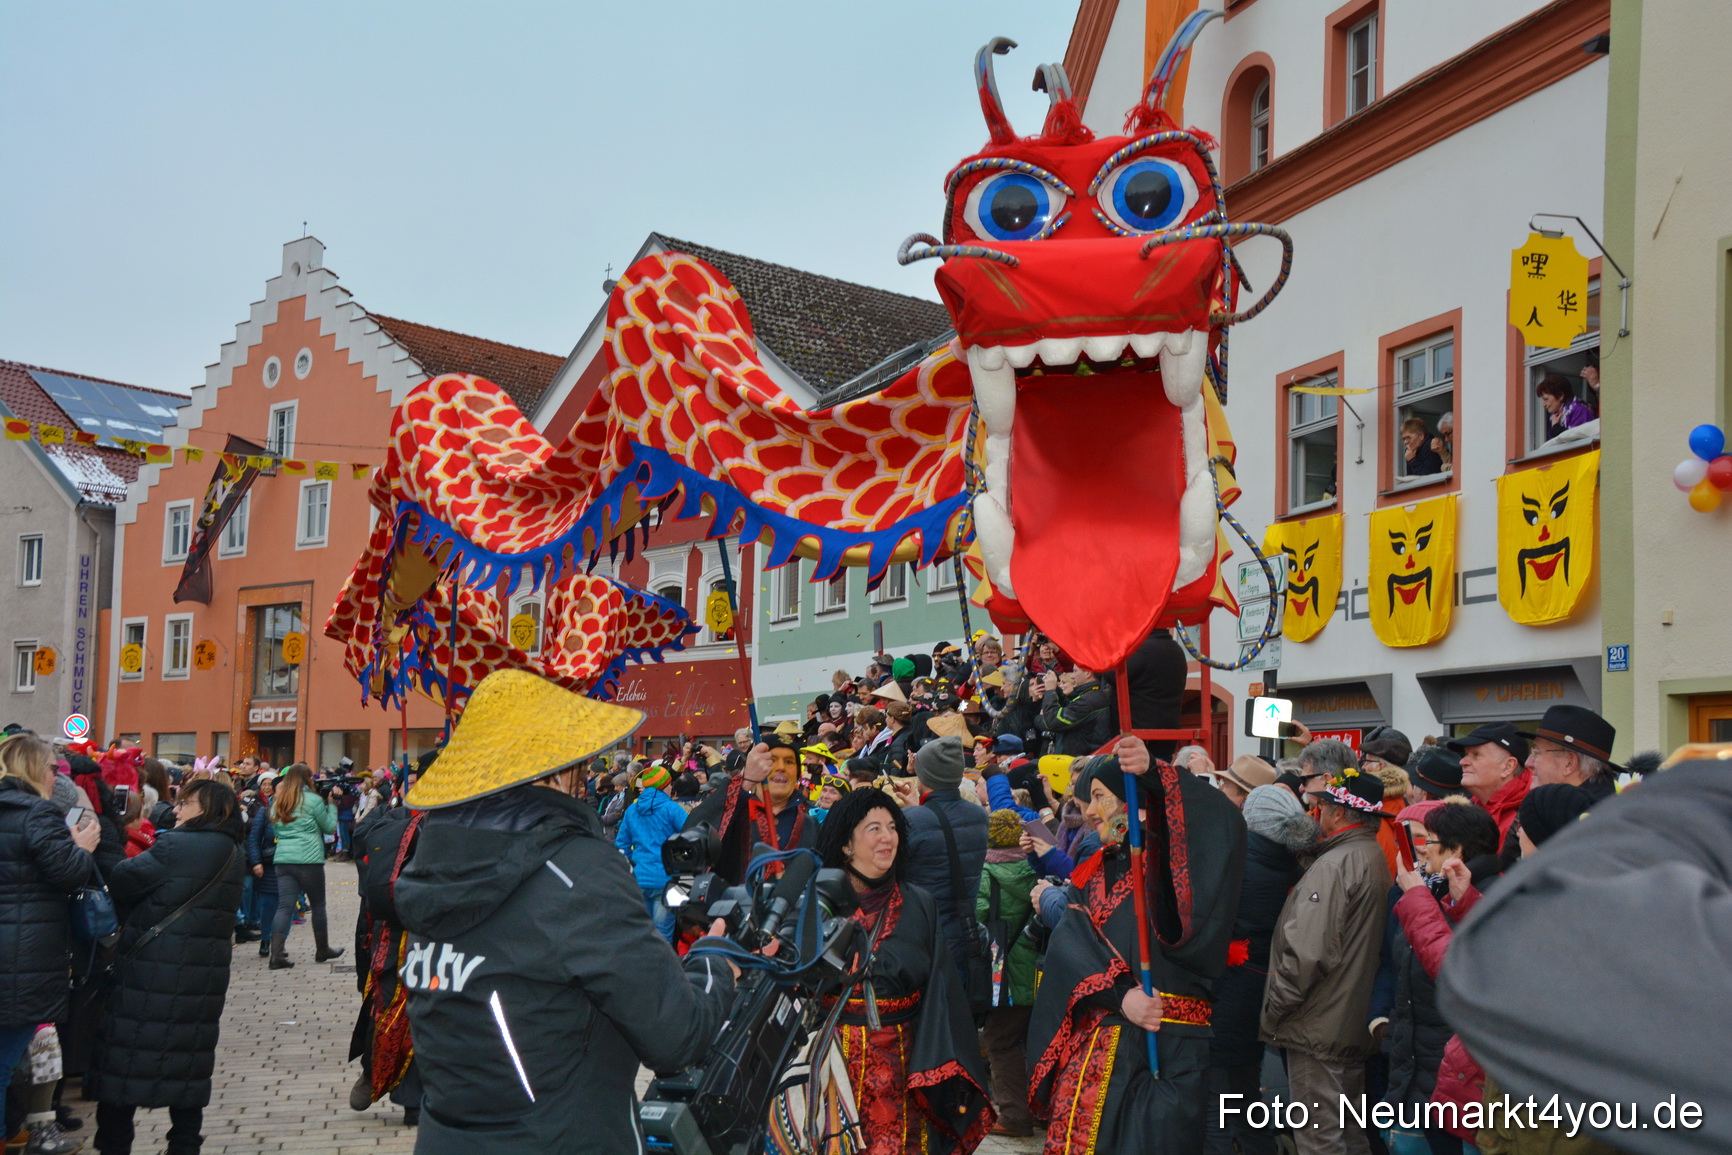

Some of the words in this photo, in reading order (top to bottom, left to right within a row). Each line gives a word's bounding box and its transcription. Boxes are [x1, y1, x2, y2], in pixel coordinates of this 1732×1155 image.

[1526, 306, 1544, 327] 人
[78, 555, 90, 619] UHREN
[1610, 647, 1625, 660] 20
[72, 627, 86, 714] SCHMUCK
[616, 679, 647, 702] Erlebnis
[1496, 681, 1564, 702] UHREN
[249, 706, 297, 722] GÖTZ
